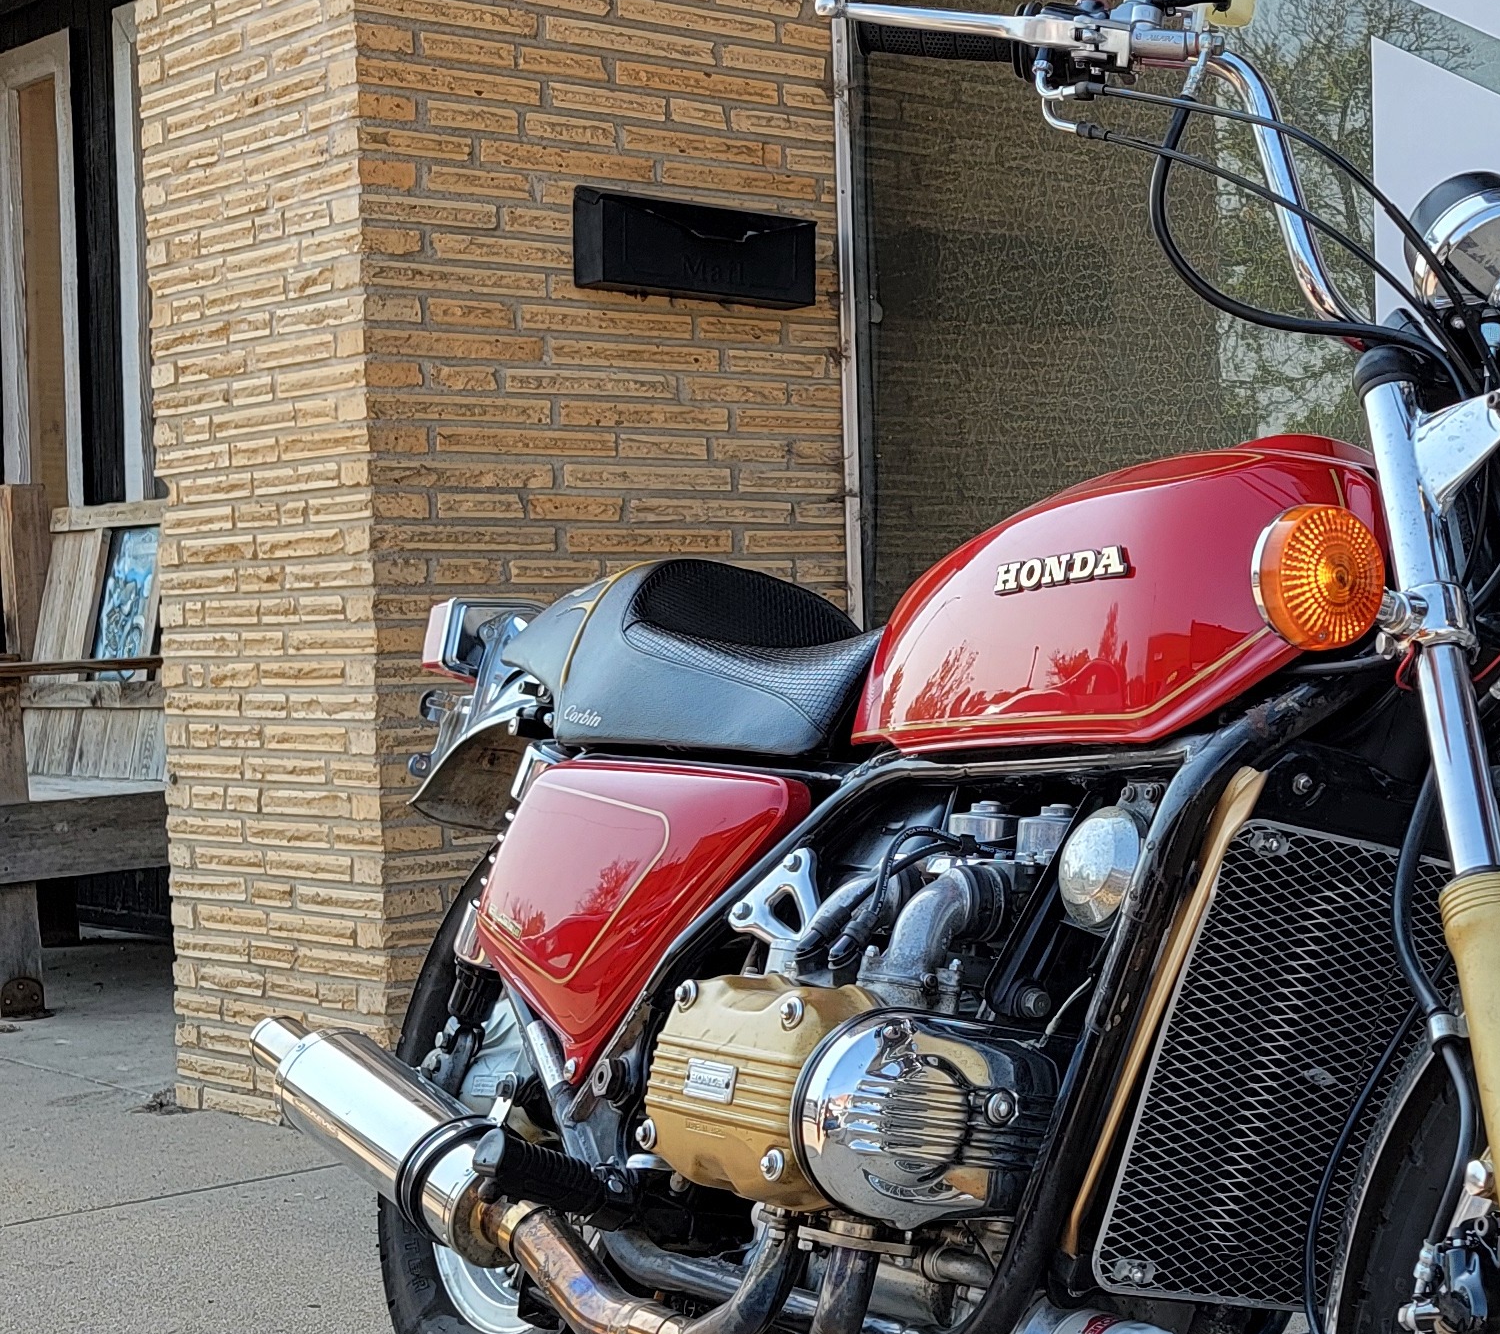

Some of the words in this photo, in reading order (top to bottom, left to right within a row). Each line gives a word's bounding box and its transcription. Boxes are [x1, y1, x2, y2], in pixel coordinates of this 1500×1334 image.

[681, 254, 745, 286] Mail
[993, 544, 1128, 596] HONDA
[563, 704, 602, 728] Corbin
